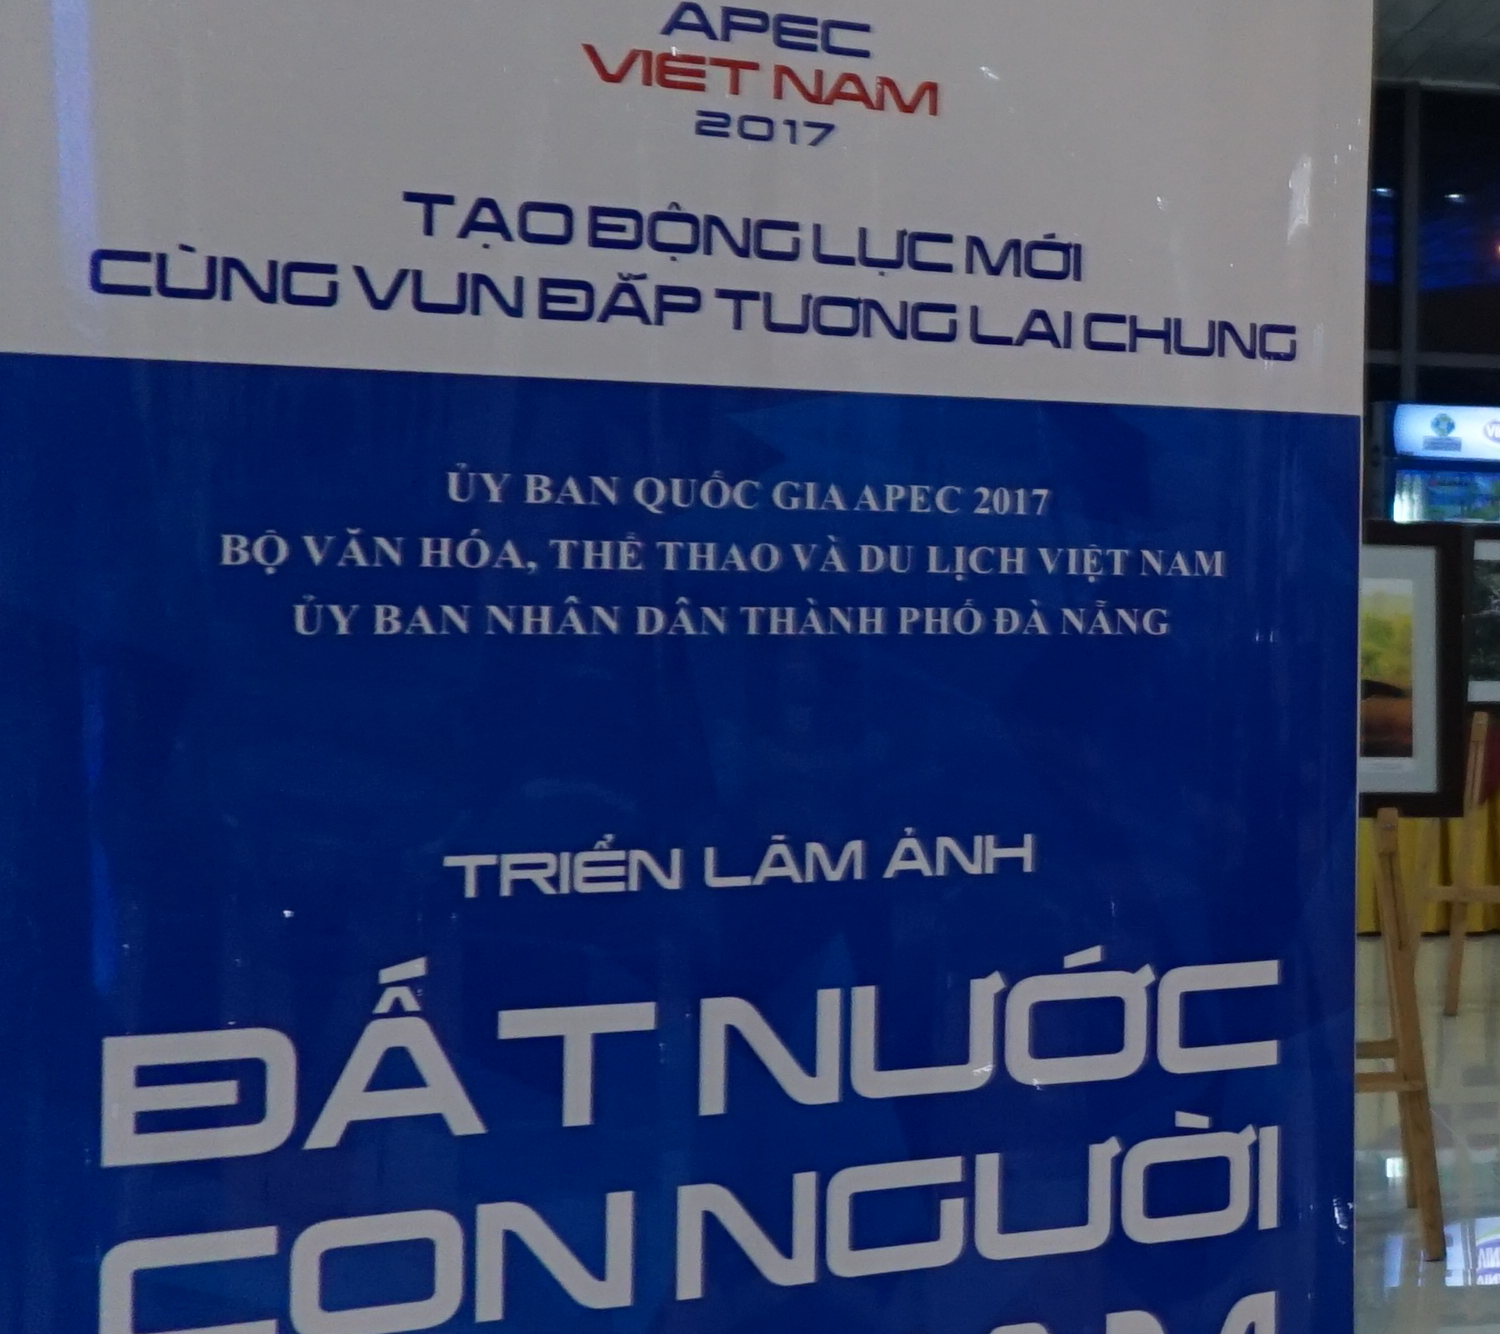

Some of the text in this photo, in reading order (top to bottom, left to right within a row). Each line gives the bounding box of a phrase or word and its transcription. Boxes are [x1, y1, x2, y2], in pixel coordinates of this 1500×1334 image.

[659, 1, 871, 58] APEC
[773, 63, 939, 116] NAM
[694, 110, 836, 147] 2017
[402, 191, 1084, 282] TẠO ĐỘNG LỰC MỚI
[88, 244, 339, 308] CÙNG
[352, 264, 525, 319] VUN
[714, 288, 958, 343] TƯƠNG
[970, 305, 1072, 351] LAI
[1083, 312, 1298, 362] CHUNG
[446, 462, 1051, 516] ỦY BAN QUỐC GIA APEC 2017
[220, 527, 1226, 583] BỘ VĂN HÓA, THỂ THAO VÀ DU LỊCH VIỆT NAM
[293, 594, 1170, 636] ỦY BAN NHÂN DÂN THÀNH PHỐ ĐÀ NẴNG
[442, 833, 683, 899] TRIỂN
[882, 827, 1034, 878] ẢNH
[99, 944, 1283, 1169] ĐẤT NƯỚC
[673, 1111, 1282, 1302] NGƯỜI
